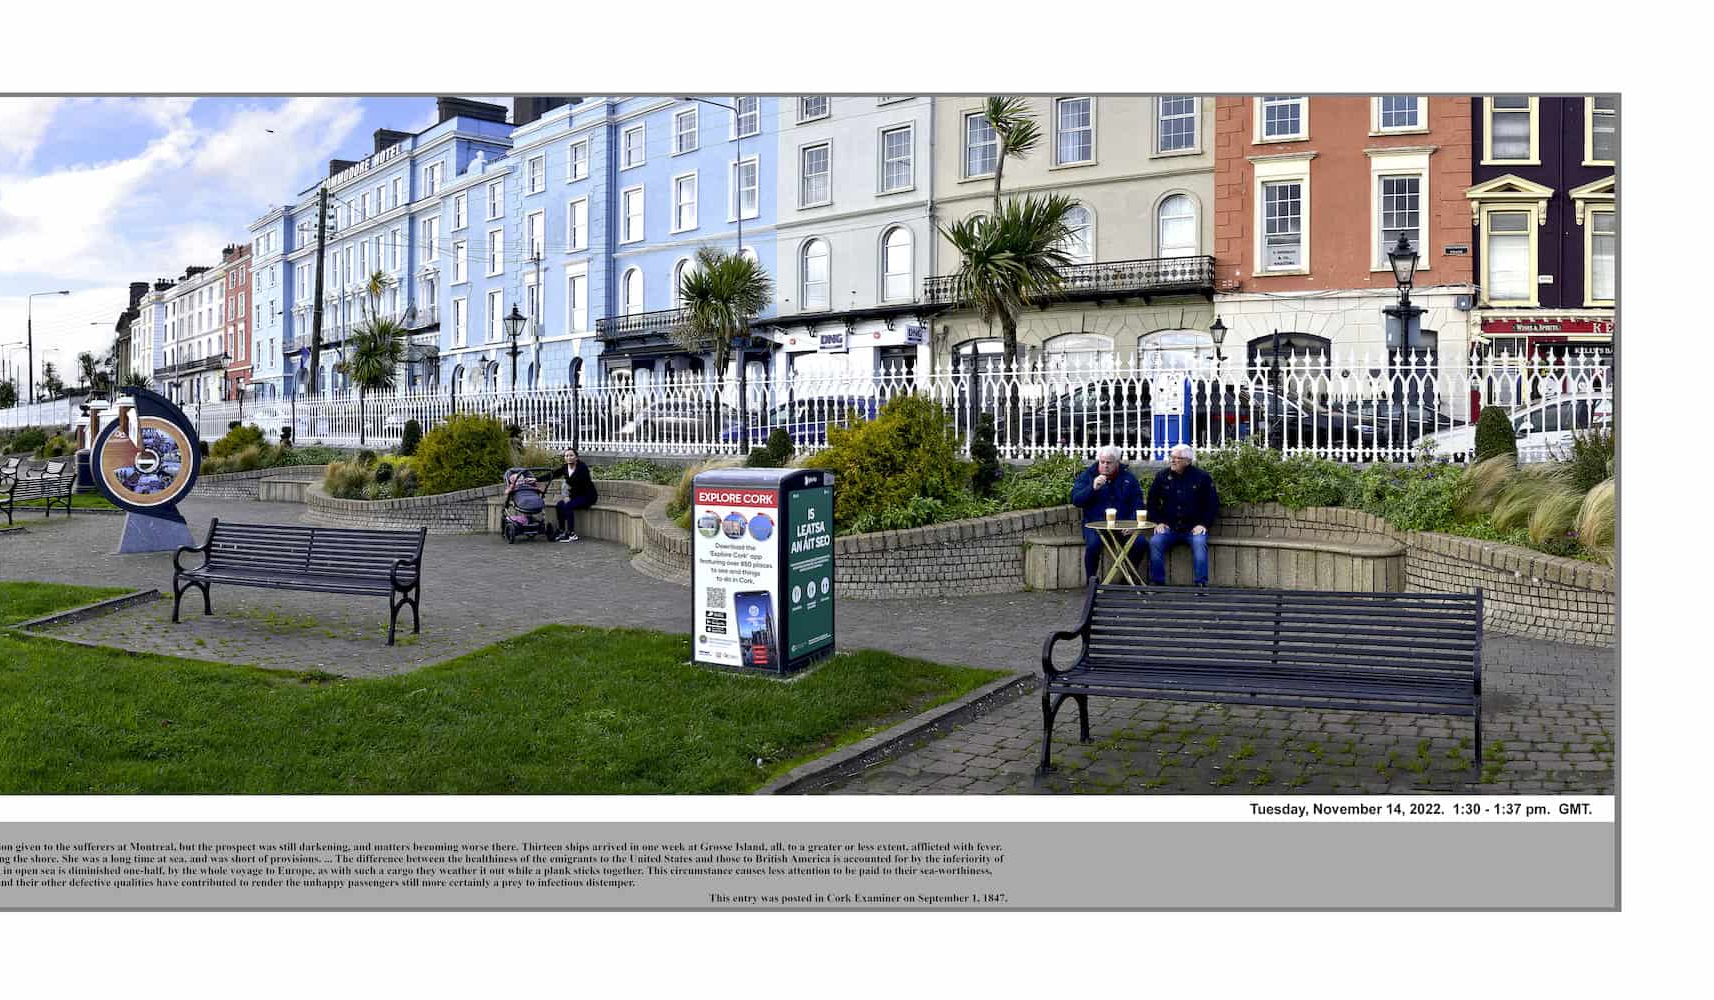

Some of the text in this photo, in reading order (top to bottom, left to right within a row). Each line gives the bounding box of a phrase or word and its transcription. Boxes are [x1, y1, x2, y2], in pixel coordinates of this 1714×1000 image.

[375, 144, 401, 165] HOTEL
[908, 327, 922, 338] DNG
[820, 333, 843, 345] DNG
[698, 492, 773, 504] EXPLORE CORK
[807, 508, 815, 521] IS
[796, 521, 826, 537] LEATSA
[715, 542, 745, 551] Download
[790, 541, 802, 554] AN
[815, 535, 831, 548] SEO
[752, 561, 773, 569] places
